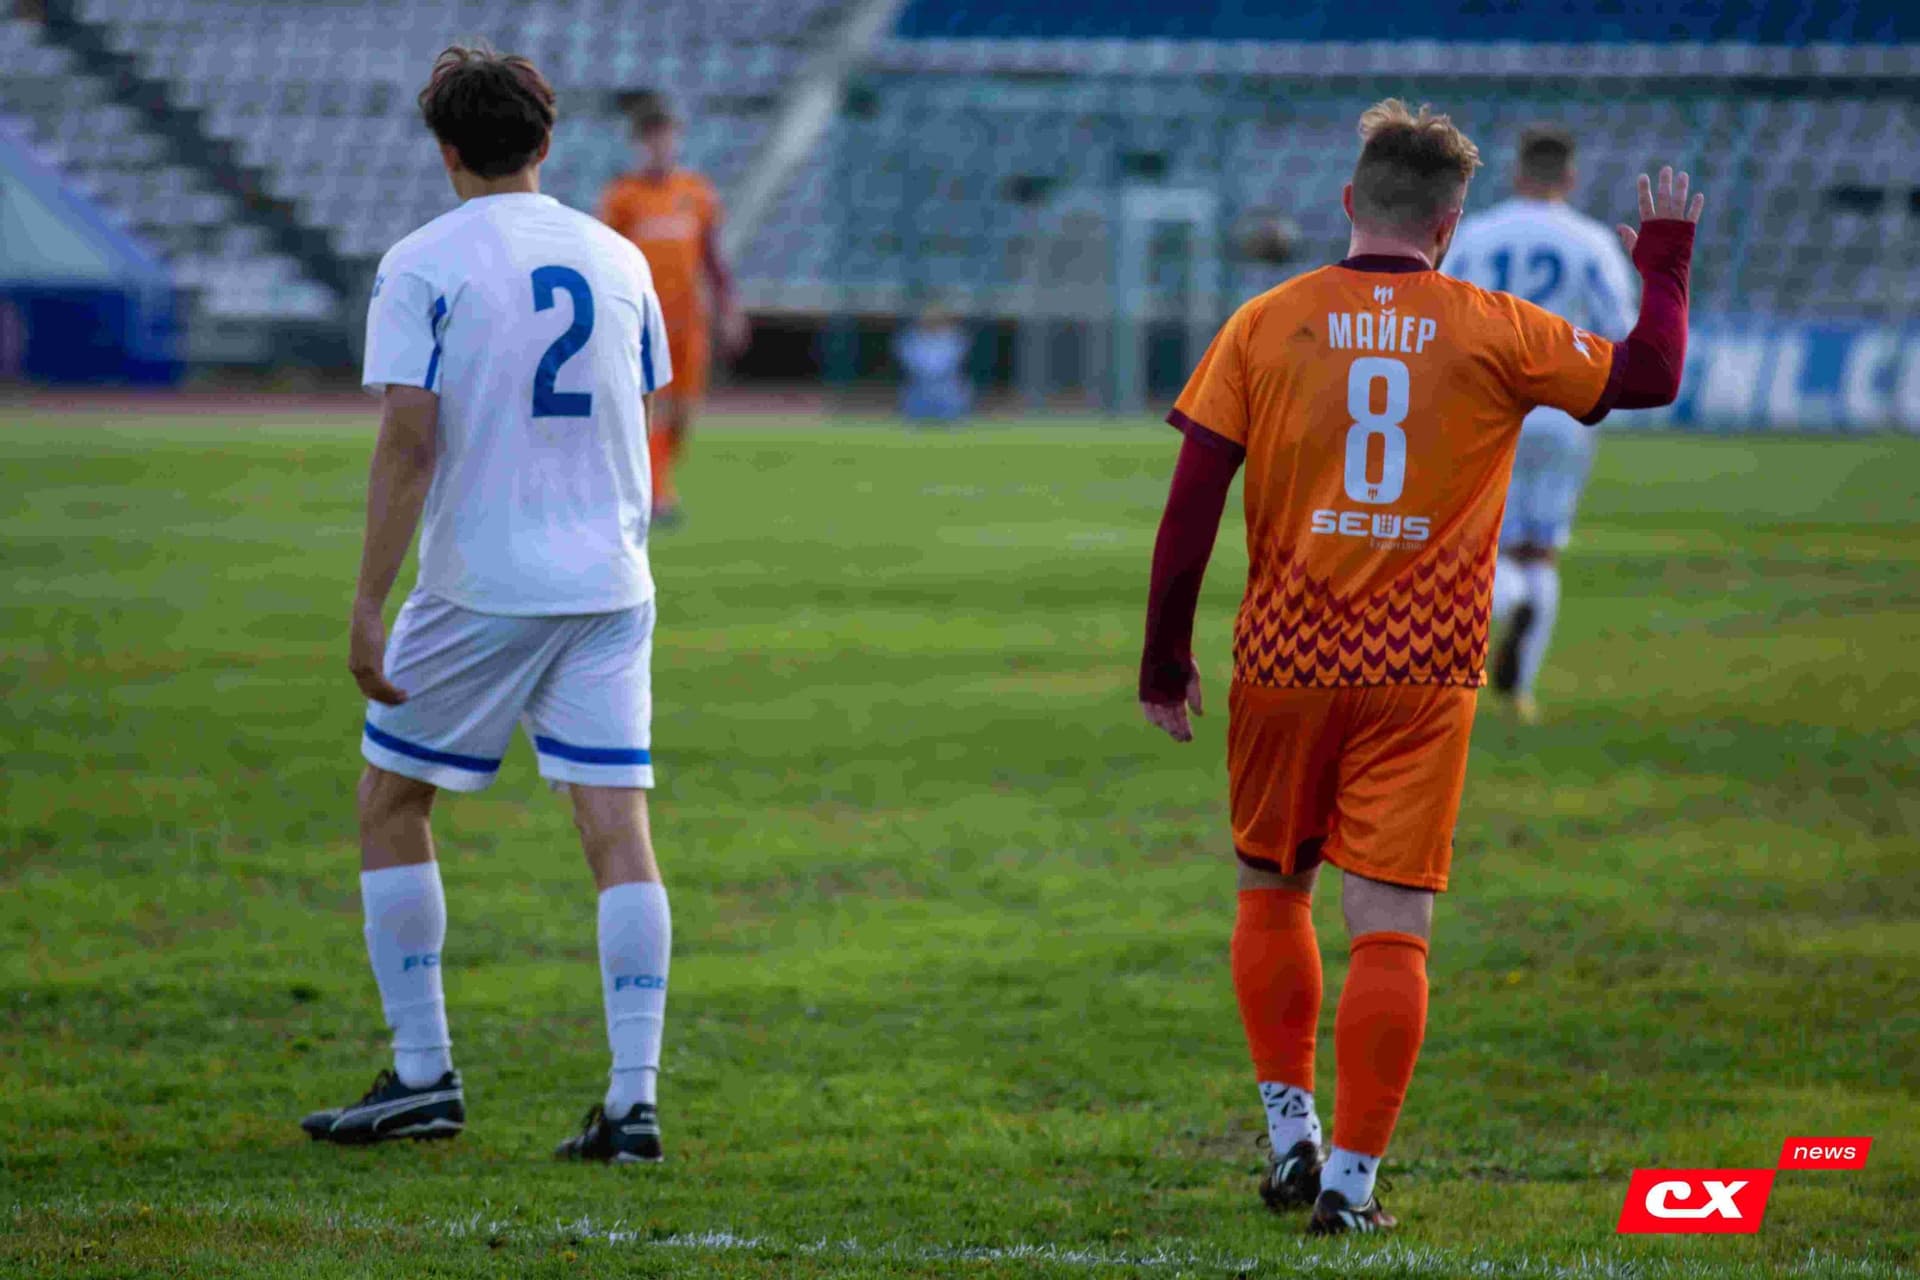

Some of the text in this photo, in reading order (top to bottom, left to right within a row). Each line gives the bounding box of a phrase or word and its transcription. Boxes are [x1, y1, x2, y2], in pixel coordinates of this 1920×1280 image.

[1488, 244, 1564, 303] 12
[531, 265, 594, 417] 2
[1328, 307, 1437, 353] МАЙЕР
[1344, 357, 1409, 504] 8
